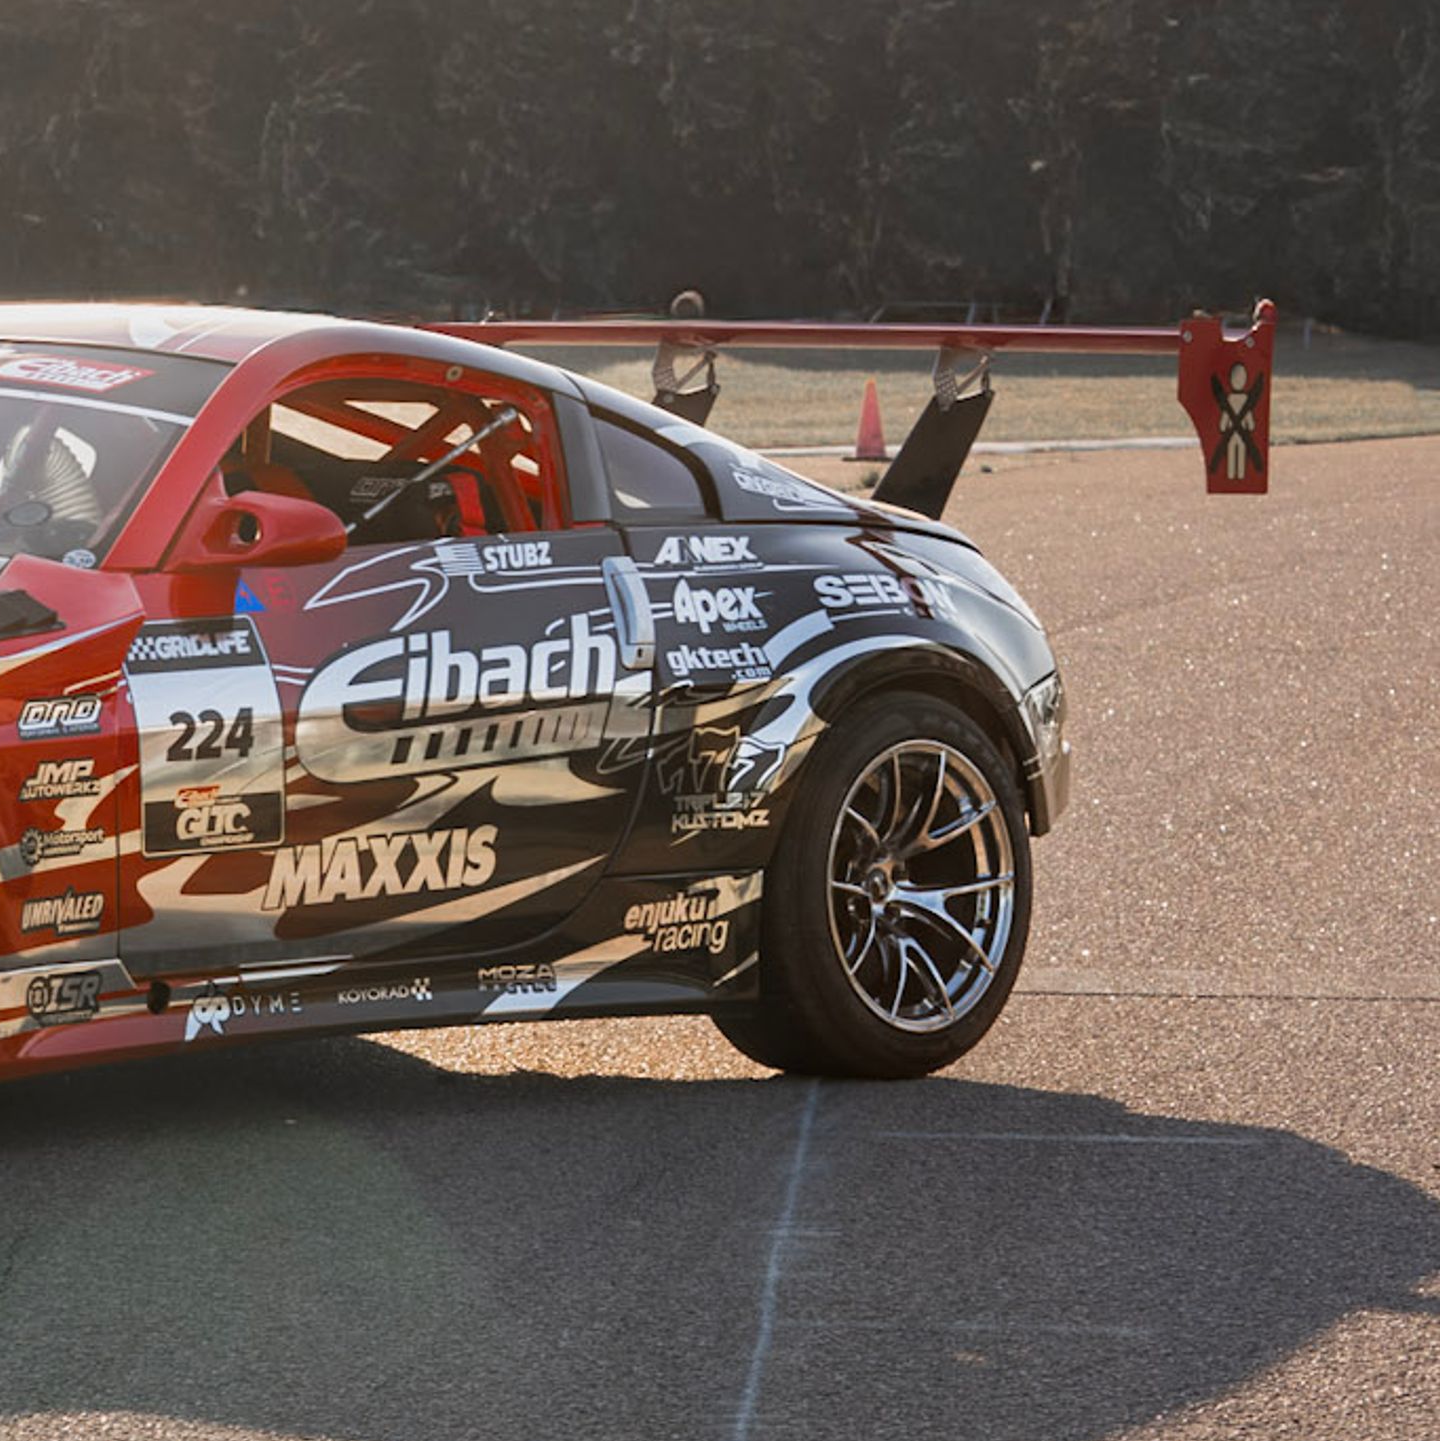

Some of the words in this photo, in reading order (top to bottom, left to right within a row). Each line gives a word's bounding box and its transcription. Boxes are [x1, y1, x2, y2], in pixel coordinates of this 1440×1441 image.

[483, 541, 553, 572] STUBZ
[673, 578, 764, 634] Apex
[813, 574, 959, 613] SEBON
[155, 630, 252, 659] GRIDLIFE
[666, 643, 768, 676] gktech
[295, 612, 617, 783] Eibach
[166, 707, 254, 762] 224
[26, 760, 95, 787] JMP
[176, 802, 251, 840] GLTC
[262, 824, 498, 910] MAXXIS
[21, 890, 104, 932] UNRIVALED
[624, 891, 706, 935] enjuku
[653, 919, 730, 954] racing
[49, 972, 98, 1010] ISR
[478, 964, 554, 980] MOZA
[232, 992, 302, 1016] DYME
[338, 985, 409, 1004] KOYORAD
